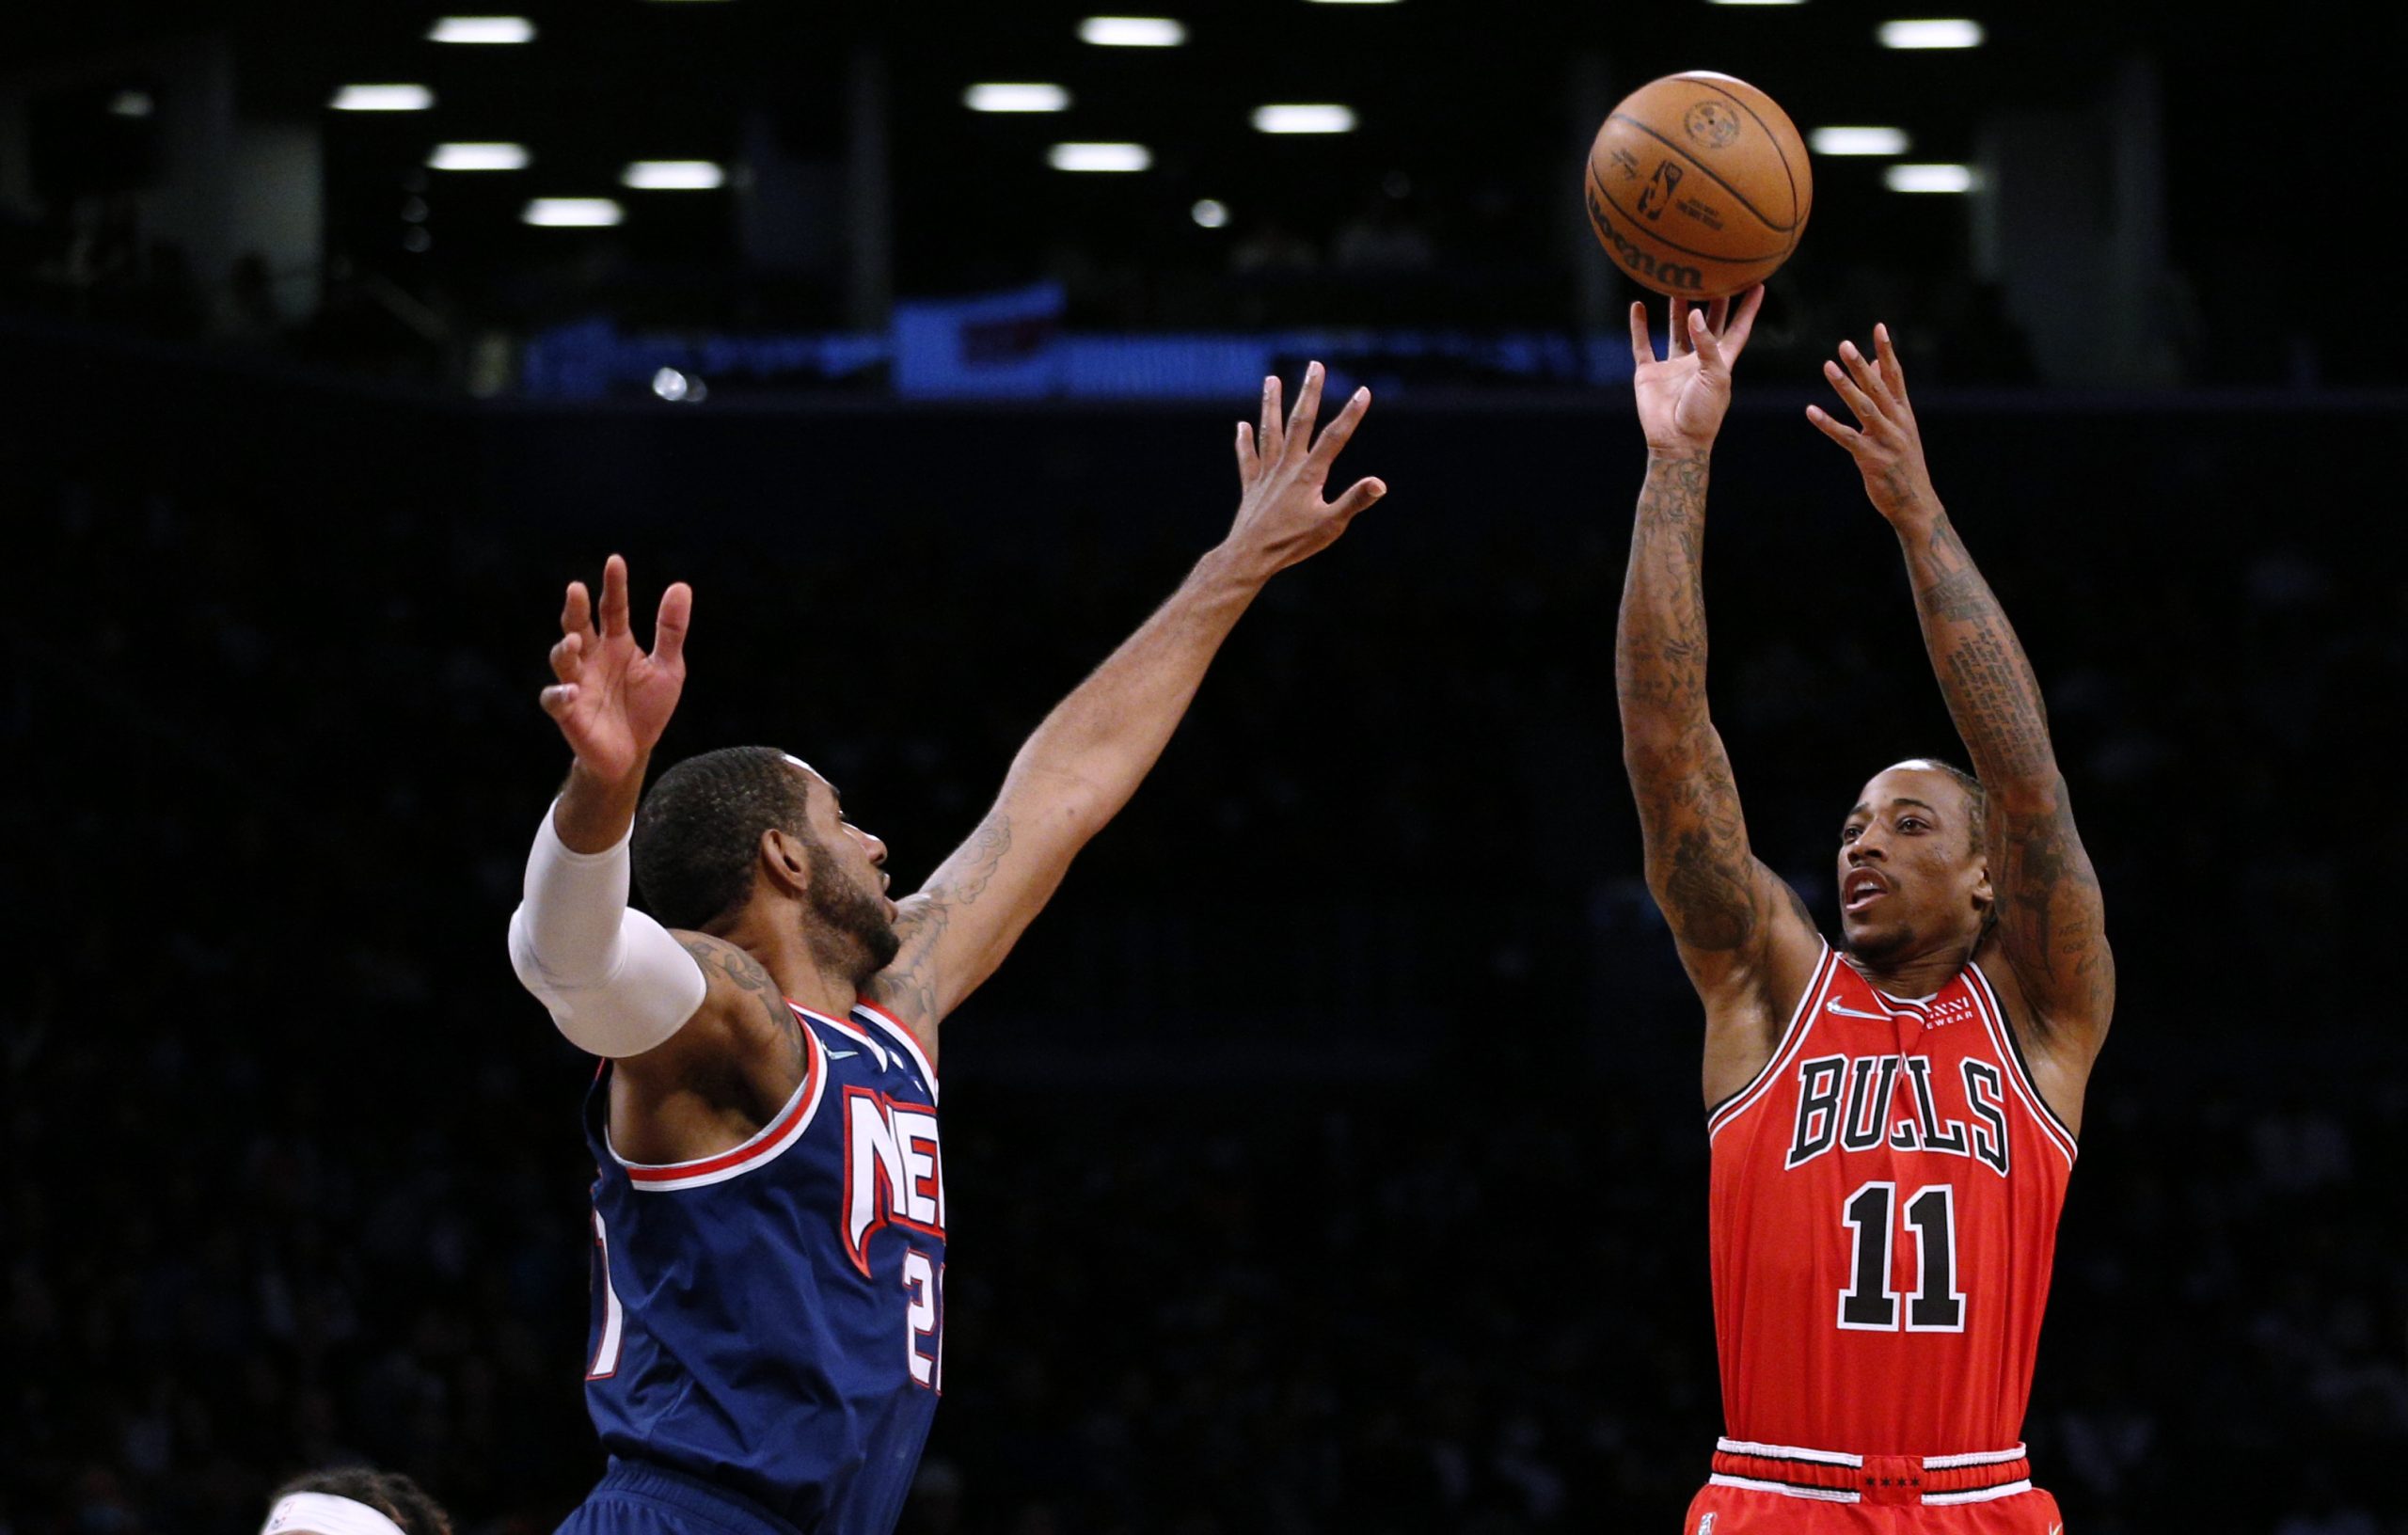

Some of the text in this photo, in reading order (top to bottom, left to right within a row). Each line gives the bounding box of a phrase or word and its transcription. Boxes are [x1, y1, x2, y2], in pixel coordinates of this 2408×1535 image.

[1926, 1011, 1973, 1030] EWEAR
[841, 1084, 945, 1279] NE
[1784, 1052, 2010, 1178] BULLS
[1837, 1181, 1966, 1333] 11
